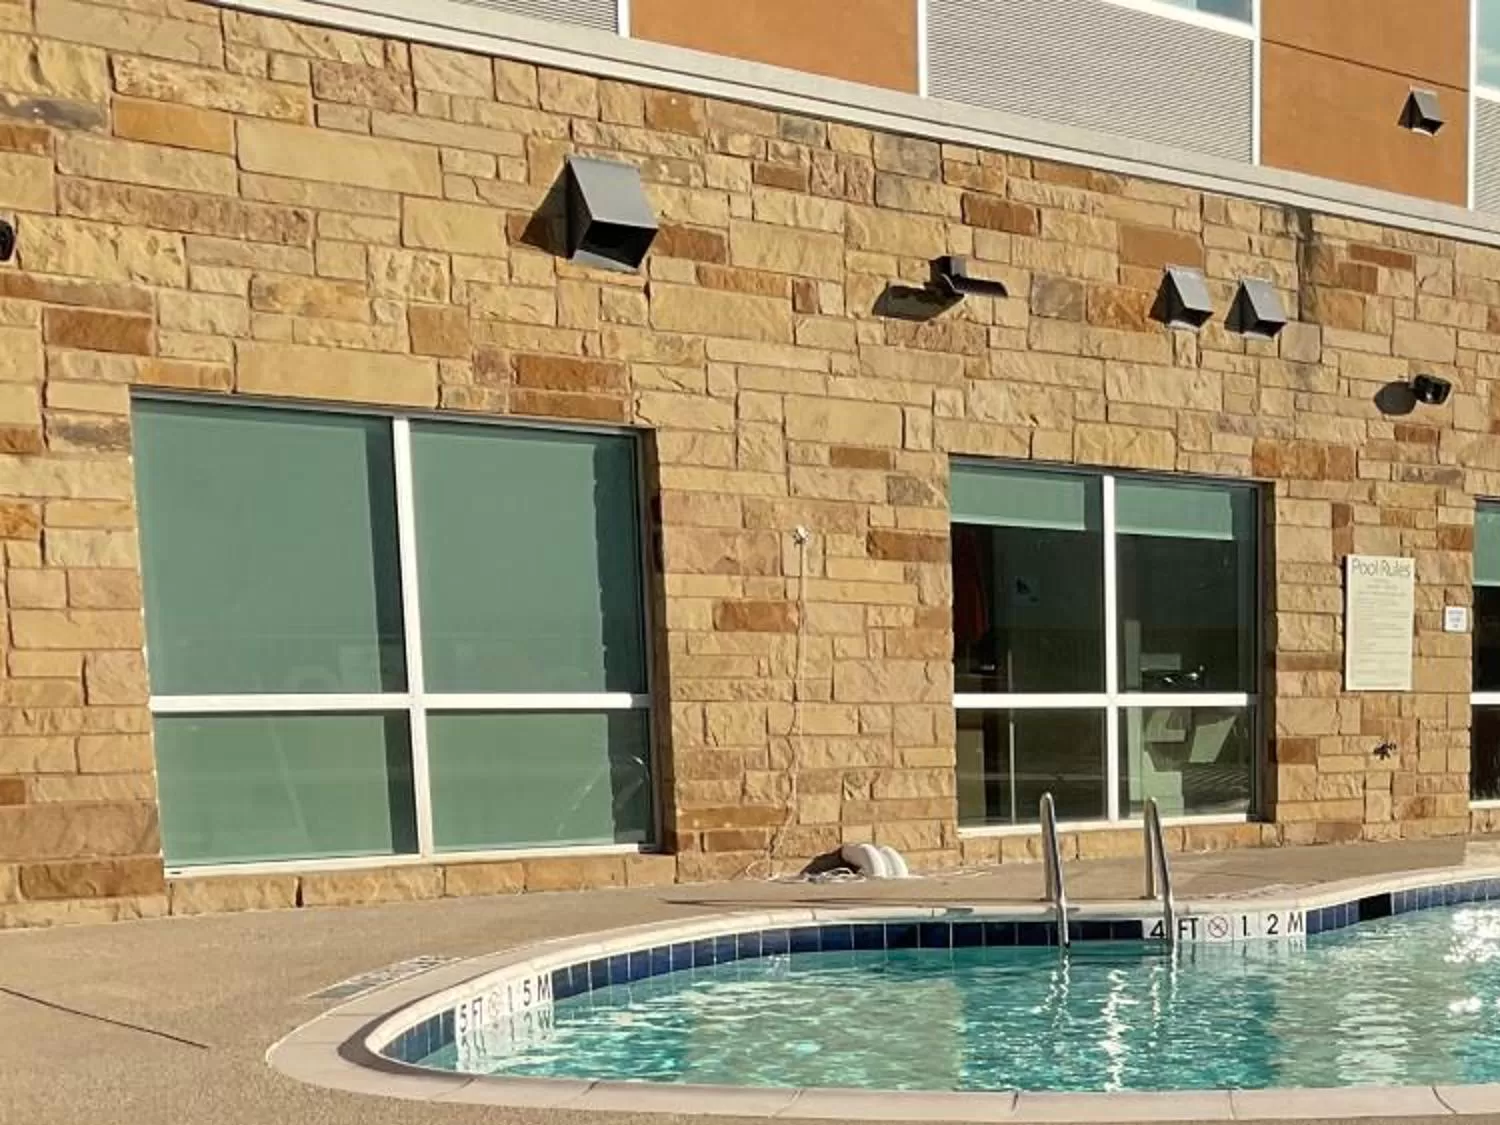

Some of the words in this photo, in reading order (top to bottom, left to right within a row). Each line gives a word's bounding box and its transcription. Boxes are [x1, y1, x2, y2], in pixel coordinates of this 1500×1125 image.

[1351, 557, 1378, 577] Pool
[1150, 919, 1165, 938] 4
[1177, 917, 1199, 940] FT
